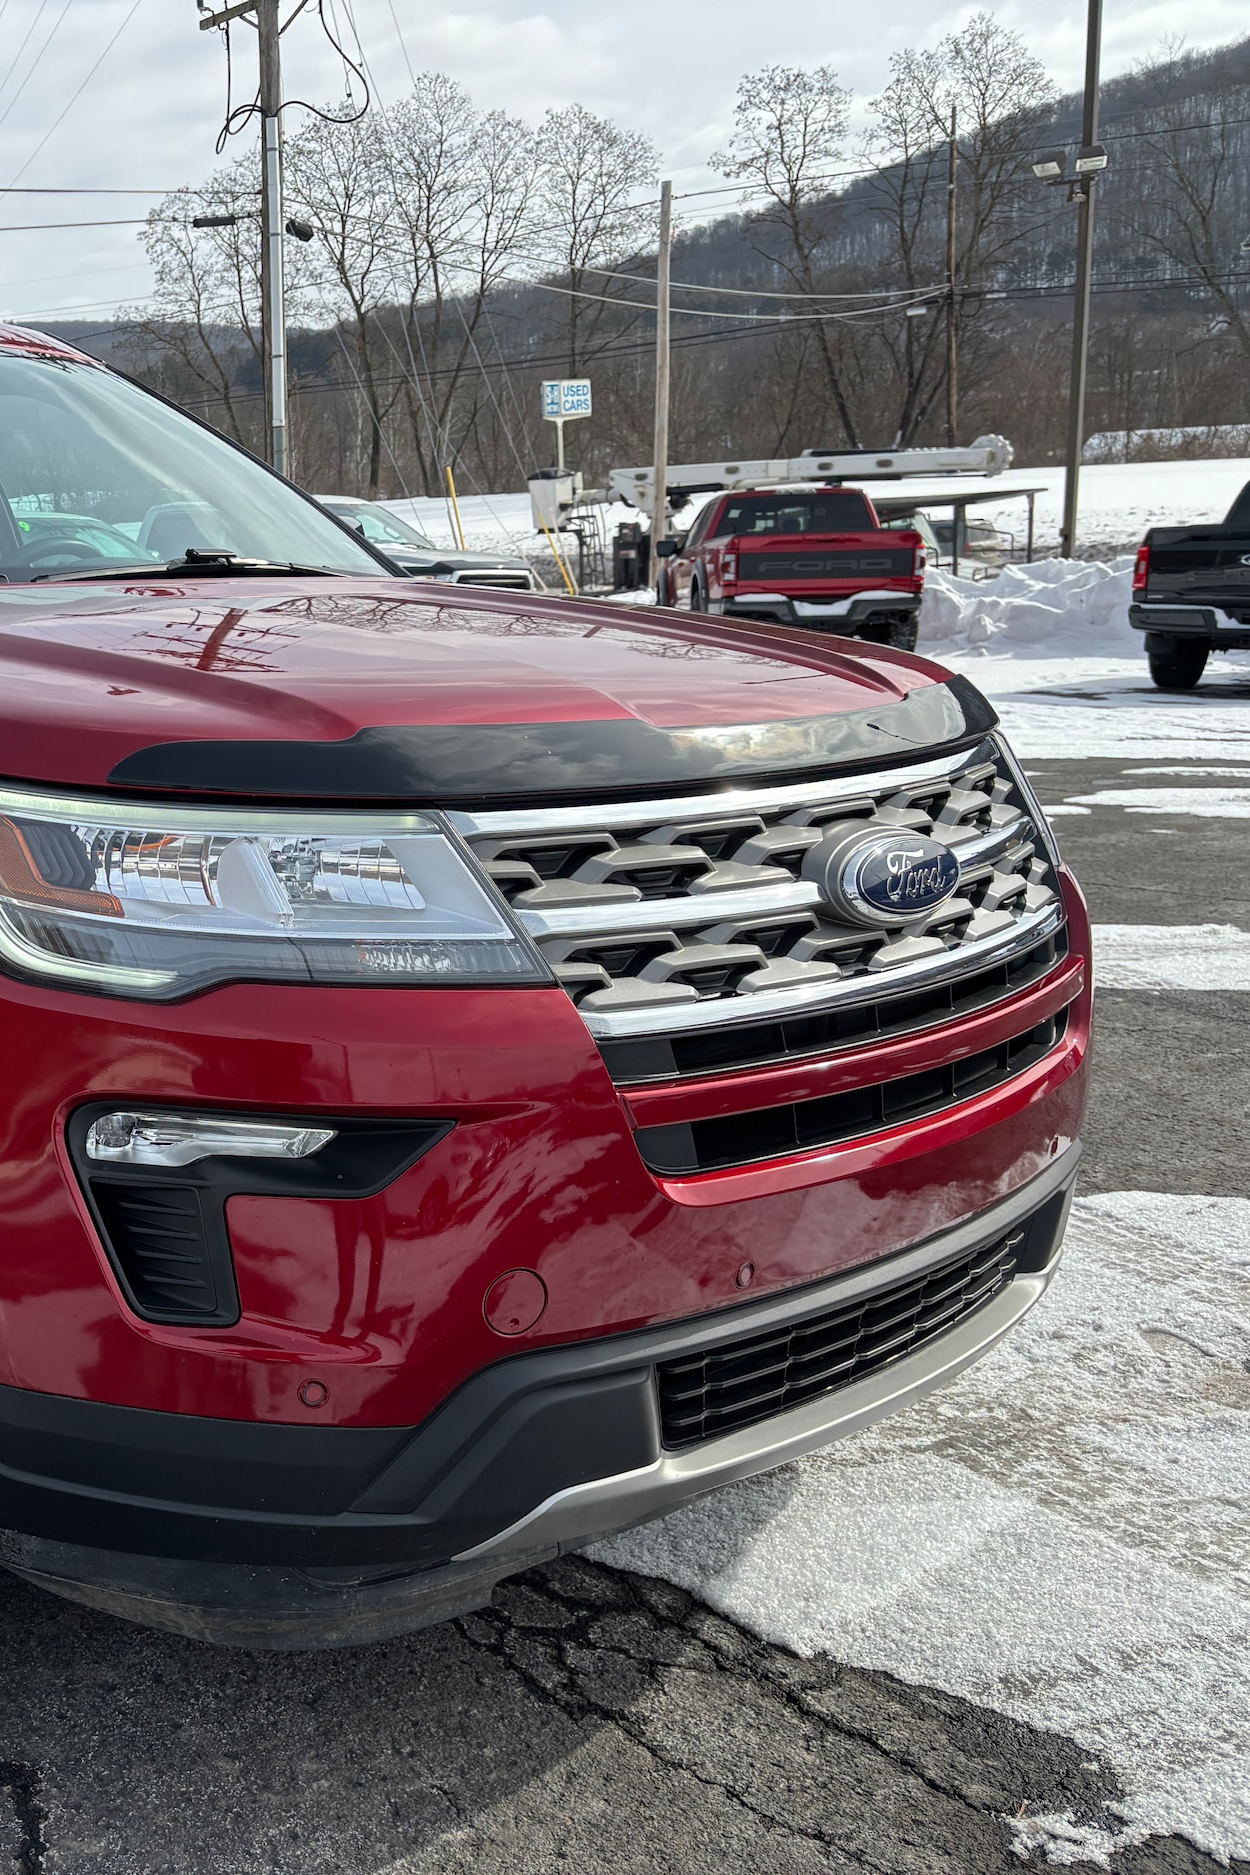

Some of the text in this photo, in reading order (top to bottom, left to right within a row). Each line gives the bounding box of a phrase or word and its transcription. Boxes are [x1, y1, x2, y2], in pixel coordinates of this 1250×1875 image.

[562, 384, 589, 397] USED
[563, 399, 590, 412] CARS
[757, 558, 892, 573] FORD
[886, 849, 956, 901] Ford
